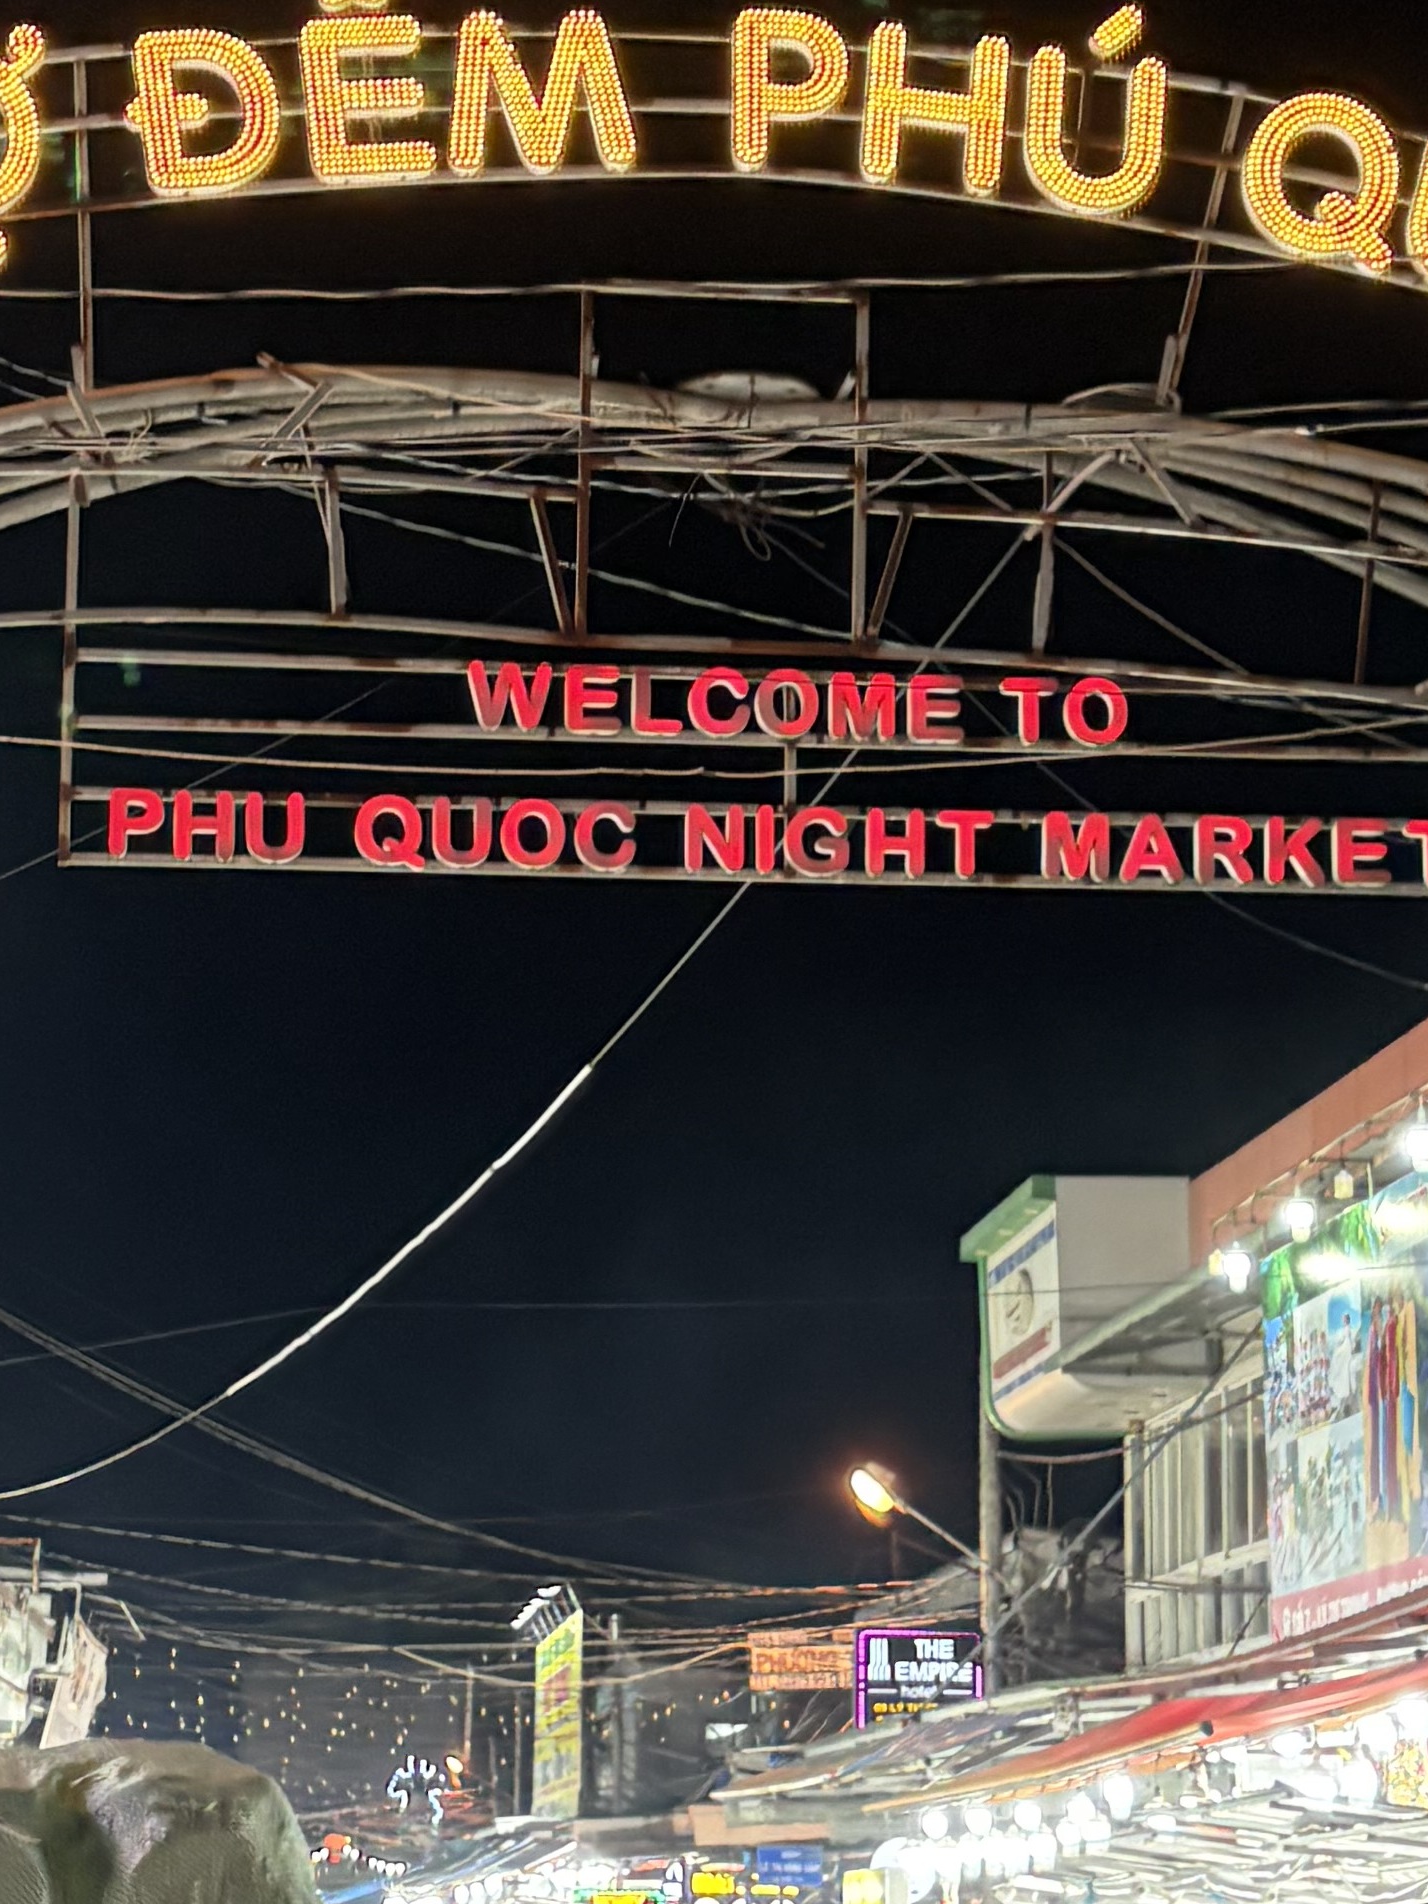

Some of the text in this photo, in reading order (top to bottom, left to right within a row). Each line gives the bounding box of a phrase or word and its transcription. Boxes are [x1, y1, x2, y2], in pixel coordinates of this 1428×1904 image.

[728, 0, 1170, 218] PHÚ
[466, 659, 1129, 749] WELCOME TO
[107, 786, 307, 866] PHU
[354, 794, 637, 875] QUOC
[682, 801, 993, 882] NIGHT
[894, 1660, 974, 1683] EMPIRE
[913, 1638, 955, 1660] THE
